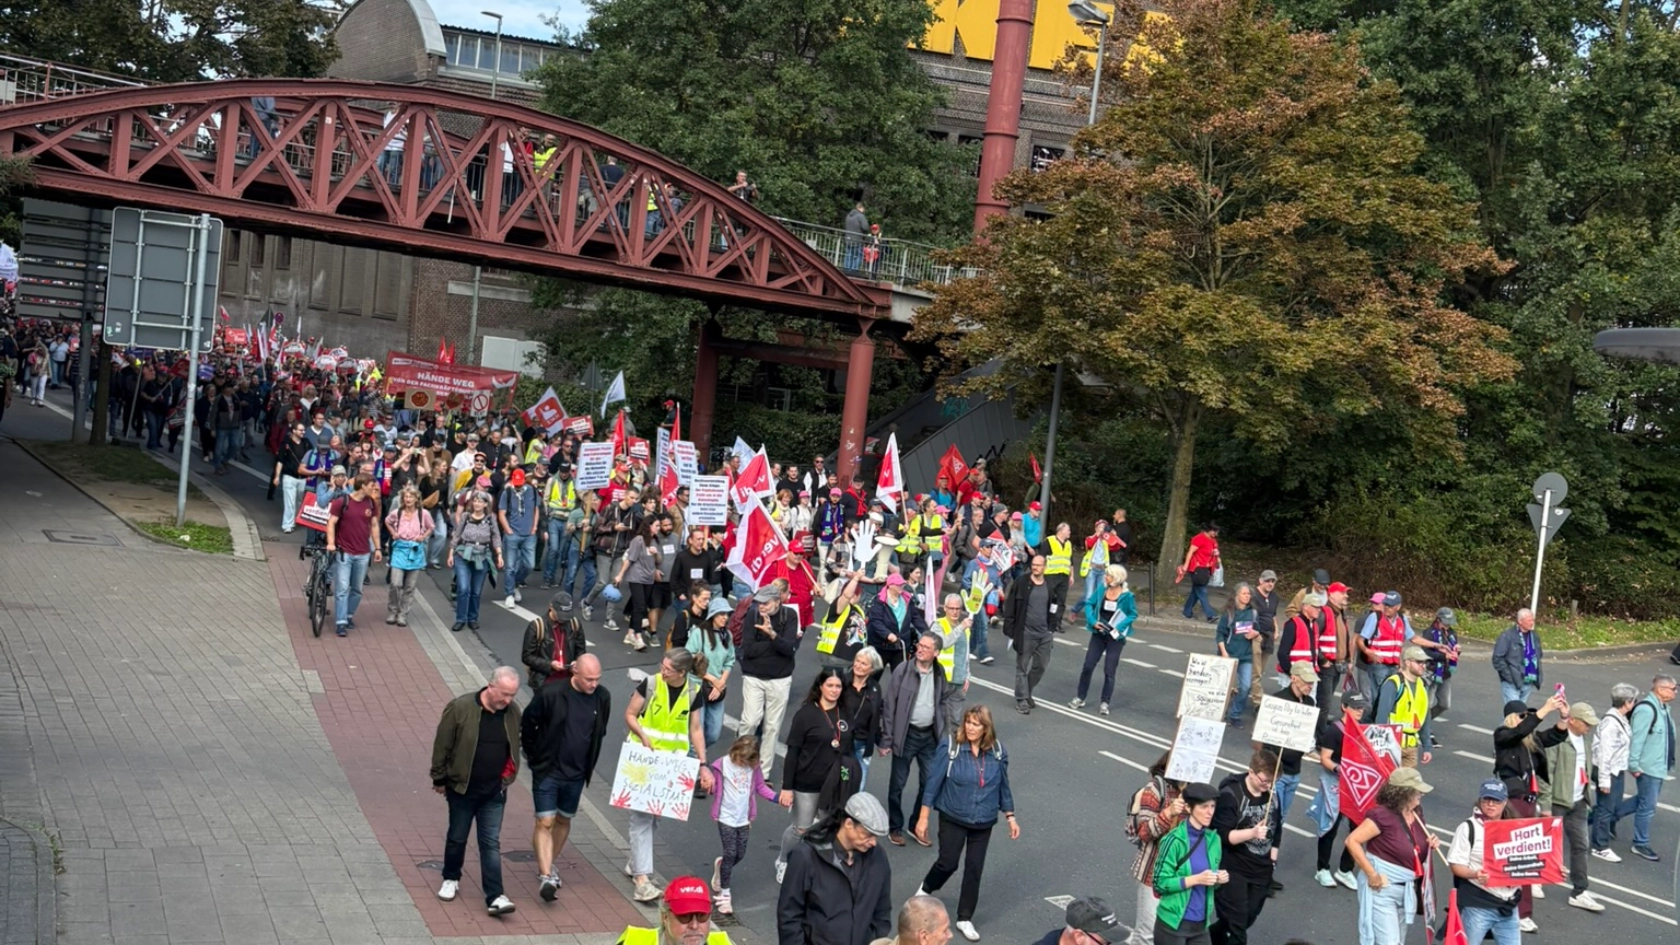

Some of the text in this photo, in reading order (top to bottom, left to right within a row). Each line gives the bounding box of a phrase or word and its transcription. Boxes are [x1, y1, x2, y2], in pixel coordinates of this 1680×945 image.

[417, 371, 475, 388] HÄNDE WEG
[1514, 826, 1540, 841] Hart
[1496, 838, 1551, 857] verdient!
[680, 885, 704, 894] ver.di
